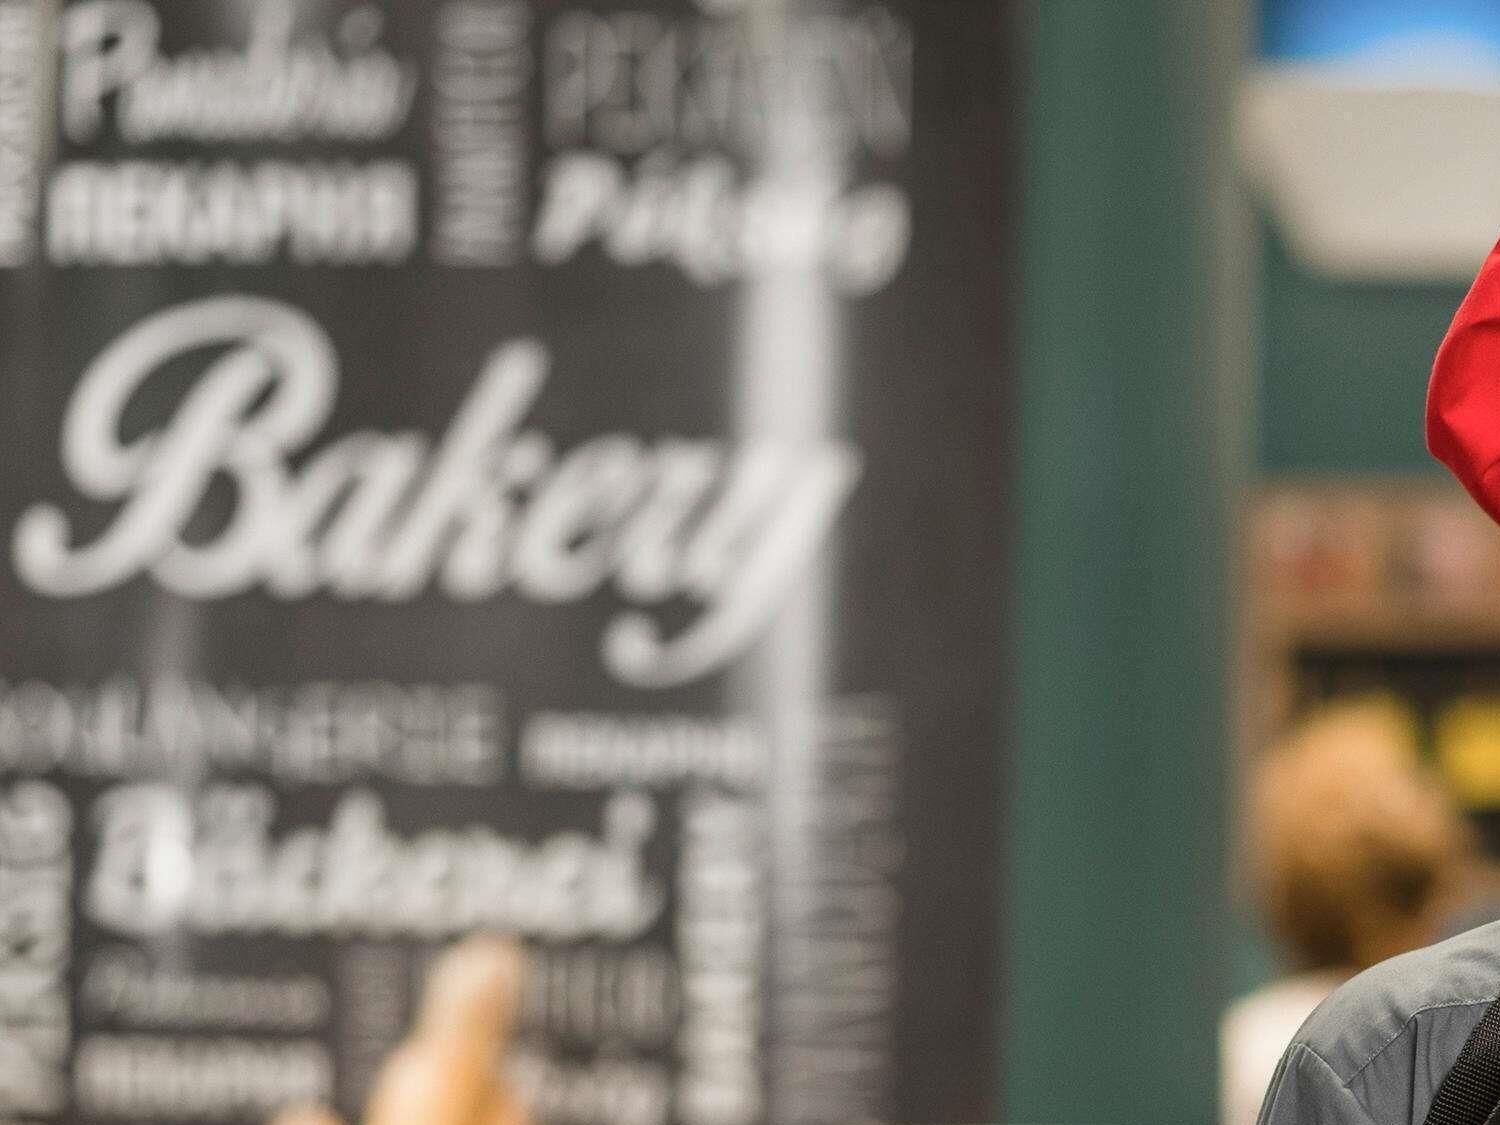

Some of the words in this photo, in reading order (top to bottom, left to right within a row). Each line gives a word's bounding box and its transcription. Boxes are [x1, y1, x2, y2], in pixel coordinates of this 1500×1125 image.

[50, 160, 418, 266] ПЕКАРНЯ
[13, 296, 860, 688] Bakery
[88, 783, 668, 938] Bäckerei
